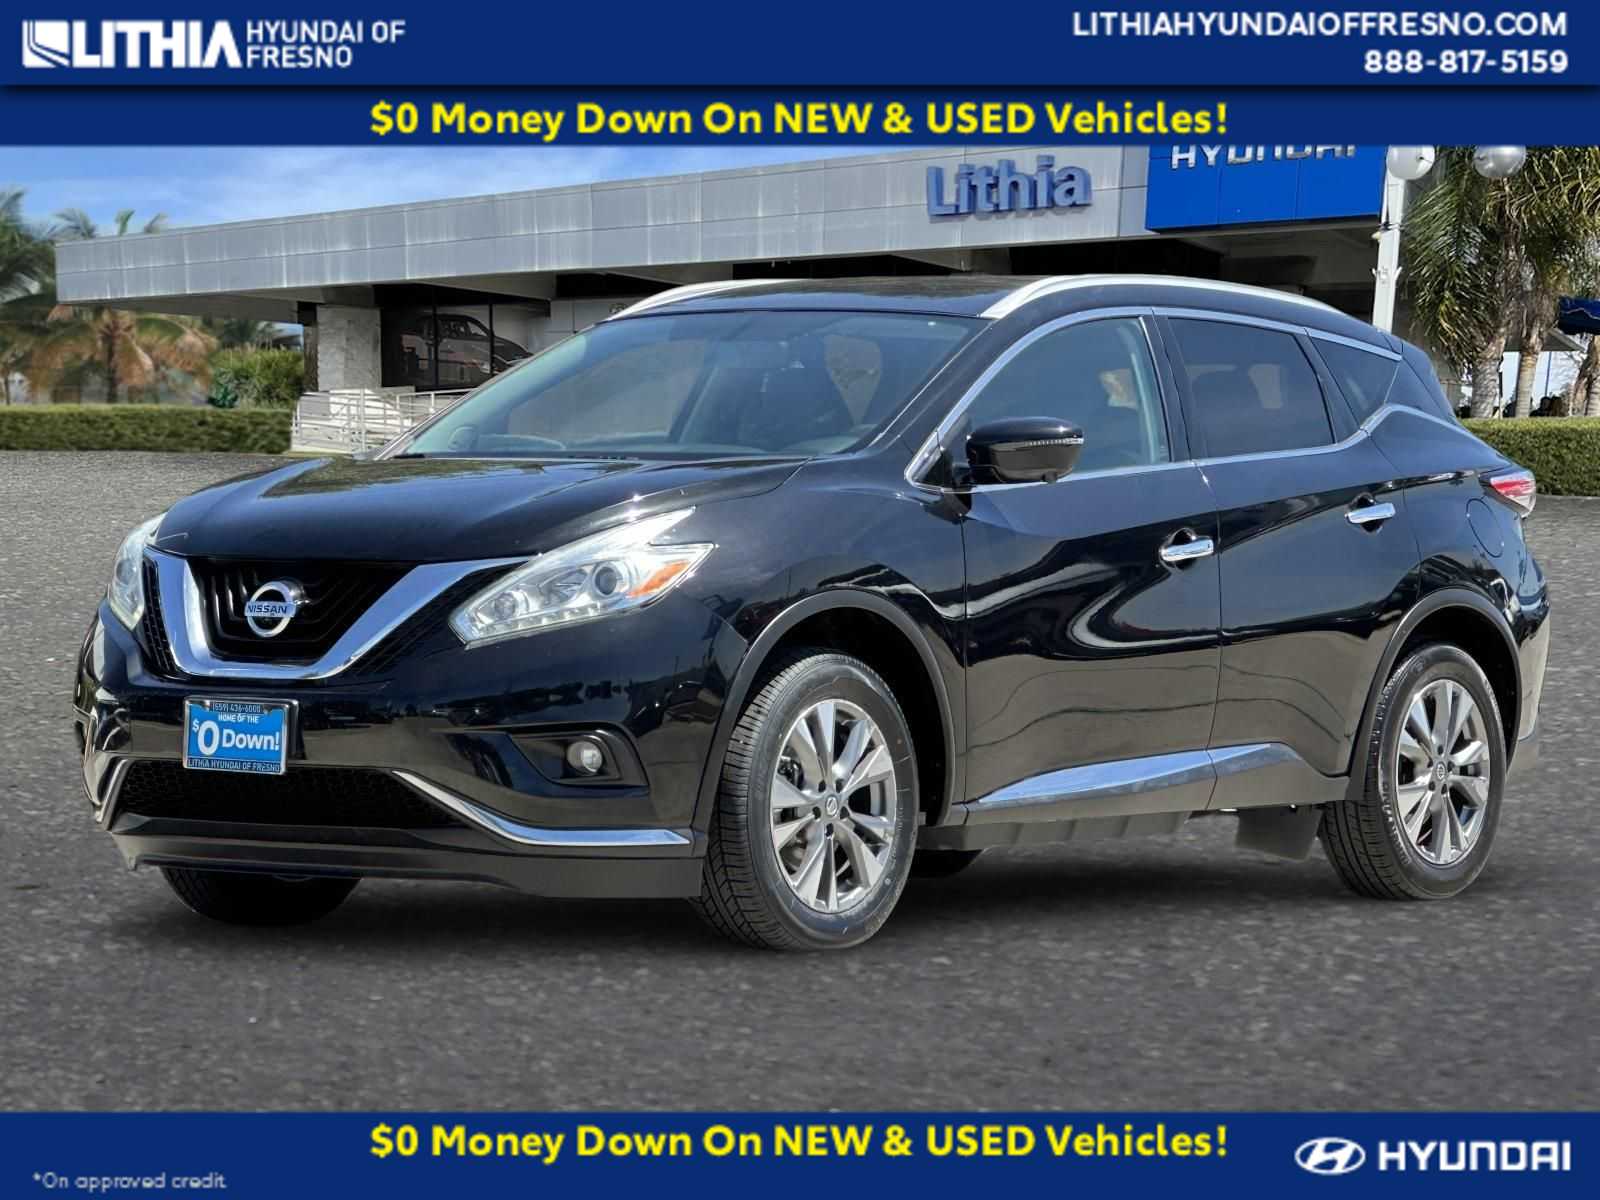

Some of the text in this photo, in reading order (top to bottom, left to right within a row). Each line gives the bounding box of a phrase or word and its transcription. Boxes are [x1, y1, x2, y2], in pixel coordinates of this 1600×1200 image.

[927, 155, 1092, 216] Lithia
[247, 604, 288, 614] NISSAN
[218, 712, 236, 722] HOME
[247, 715, 260, 724] THE
[222, 728, 280, 751] Down!
[188, 759, 210, 767] LITHIA
[211, 760, 240, 769] HYUNDAI
[242, 762, 252, 770] OF
